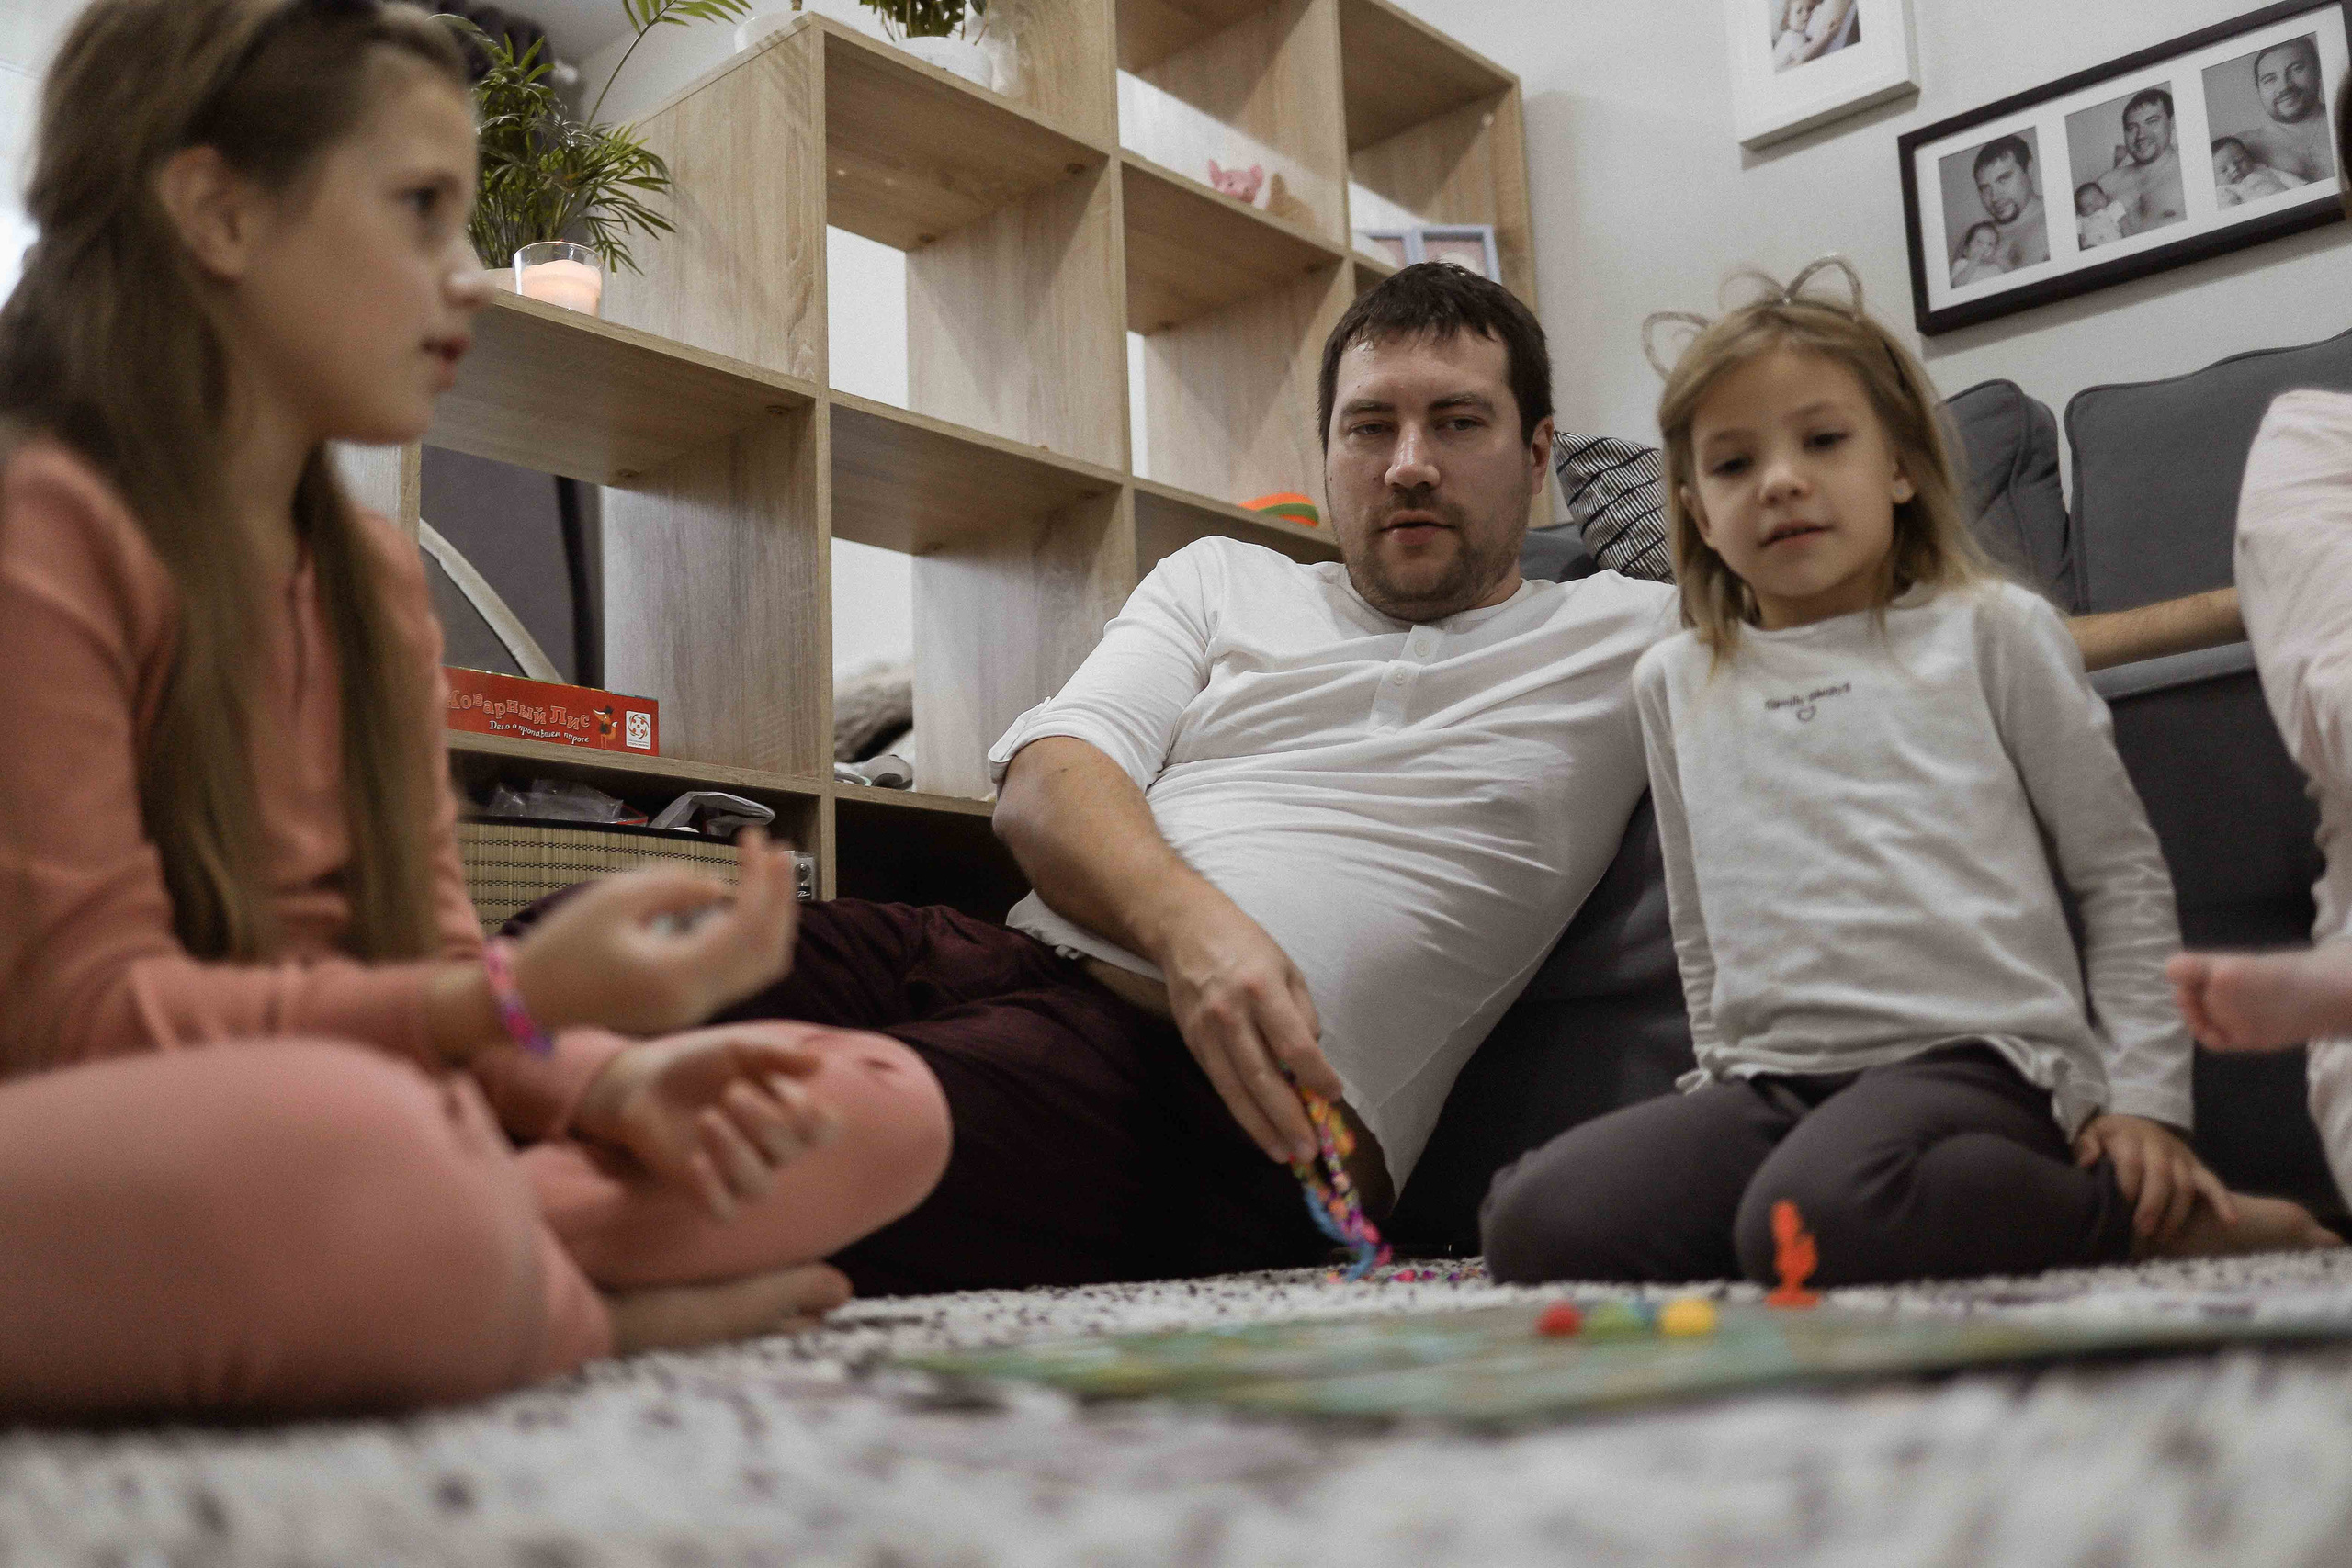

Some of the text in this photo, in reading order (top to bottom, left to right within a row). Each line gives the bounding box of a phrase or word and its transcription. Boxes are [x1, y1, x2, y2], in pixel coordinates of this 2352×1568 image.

[550, 705, 591, 730] Лис
[518, 725, 561, 739] пропавшем
[563, 732, 590, 744] пироге
